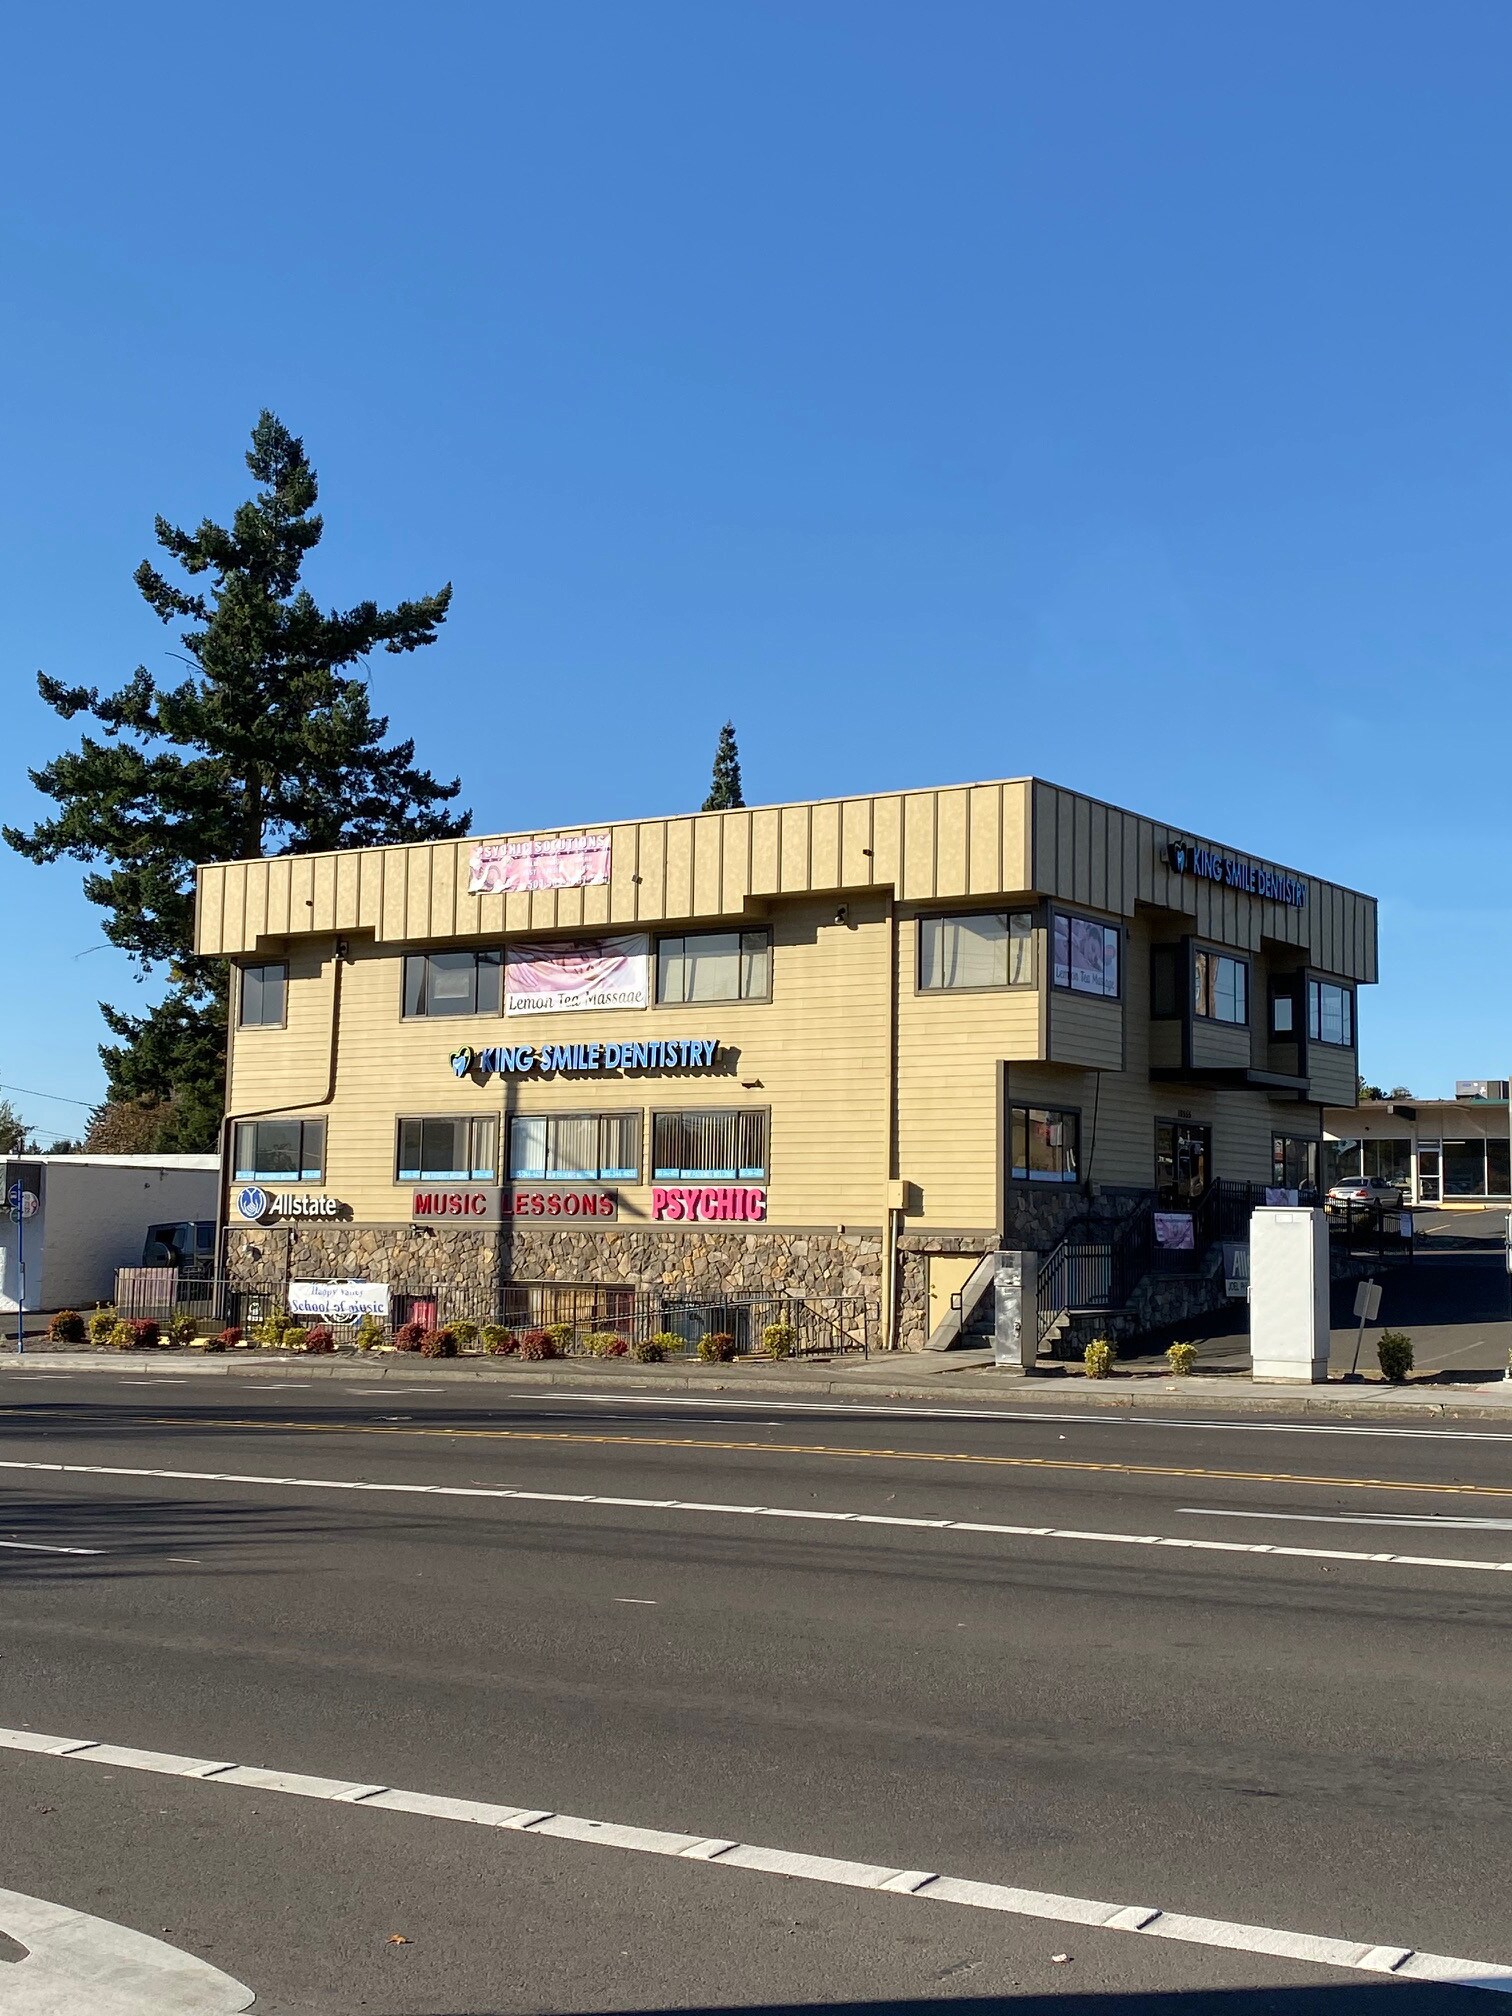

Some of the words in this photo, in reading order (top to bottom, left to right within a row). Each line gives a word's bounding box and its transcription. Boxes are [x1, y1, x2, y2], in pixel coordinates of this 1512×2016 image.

[475, 843, 532, 859] PSYCHIC
[534, 834, 606, 854] SOLUTIONS
[1193, 847, 1222, 881] KING
[1225, 859, 1256, 893] SMILE
[1257, 869, 1308, 909] DENTISTRY
[509, 995, 554, 1011] Lemon
[481, 1045, 535, 1073] KING
[540, 1043, 600, 1071] SMILE
[605, 1040, 720, 1069] DENTISTRY
[268, 1193, 338, 1216] Allstate
[414, 1193, 488, 1216] MUSIC
[501, 1192, 615, 1217] LESSONS
[652, 1188, 765, 1221] PSYCHIC
[310, 1285, 340, 1298] Happy
[292, 1299, 330, 1313] School
[333, 1300, 346, 1313] of
